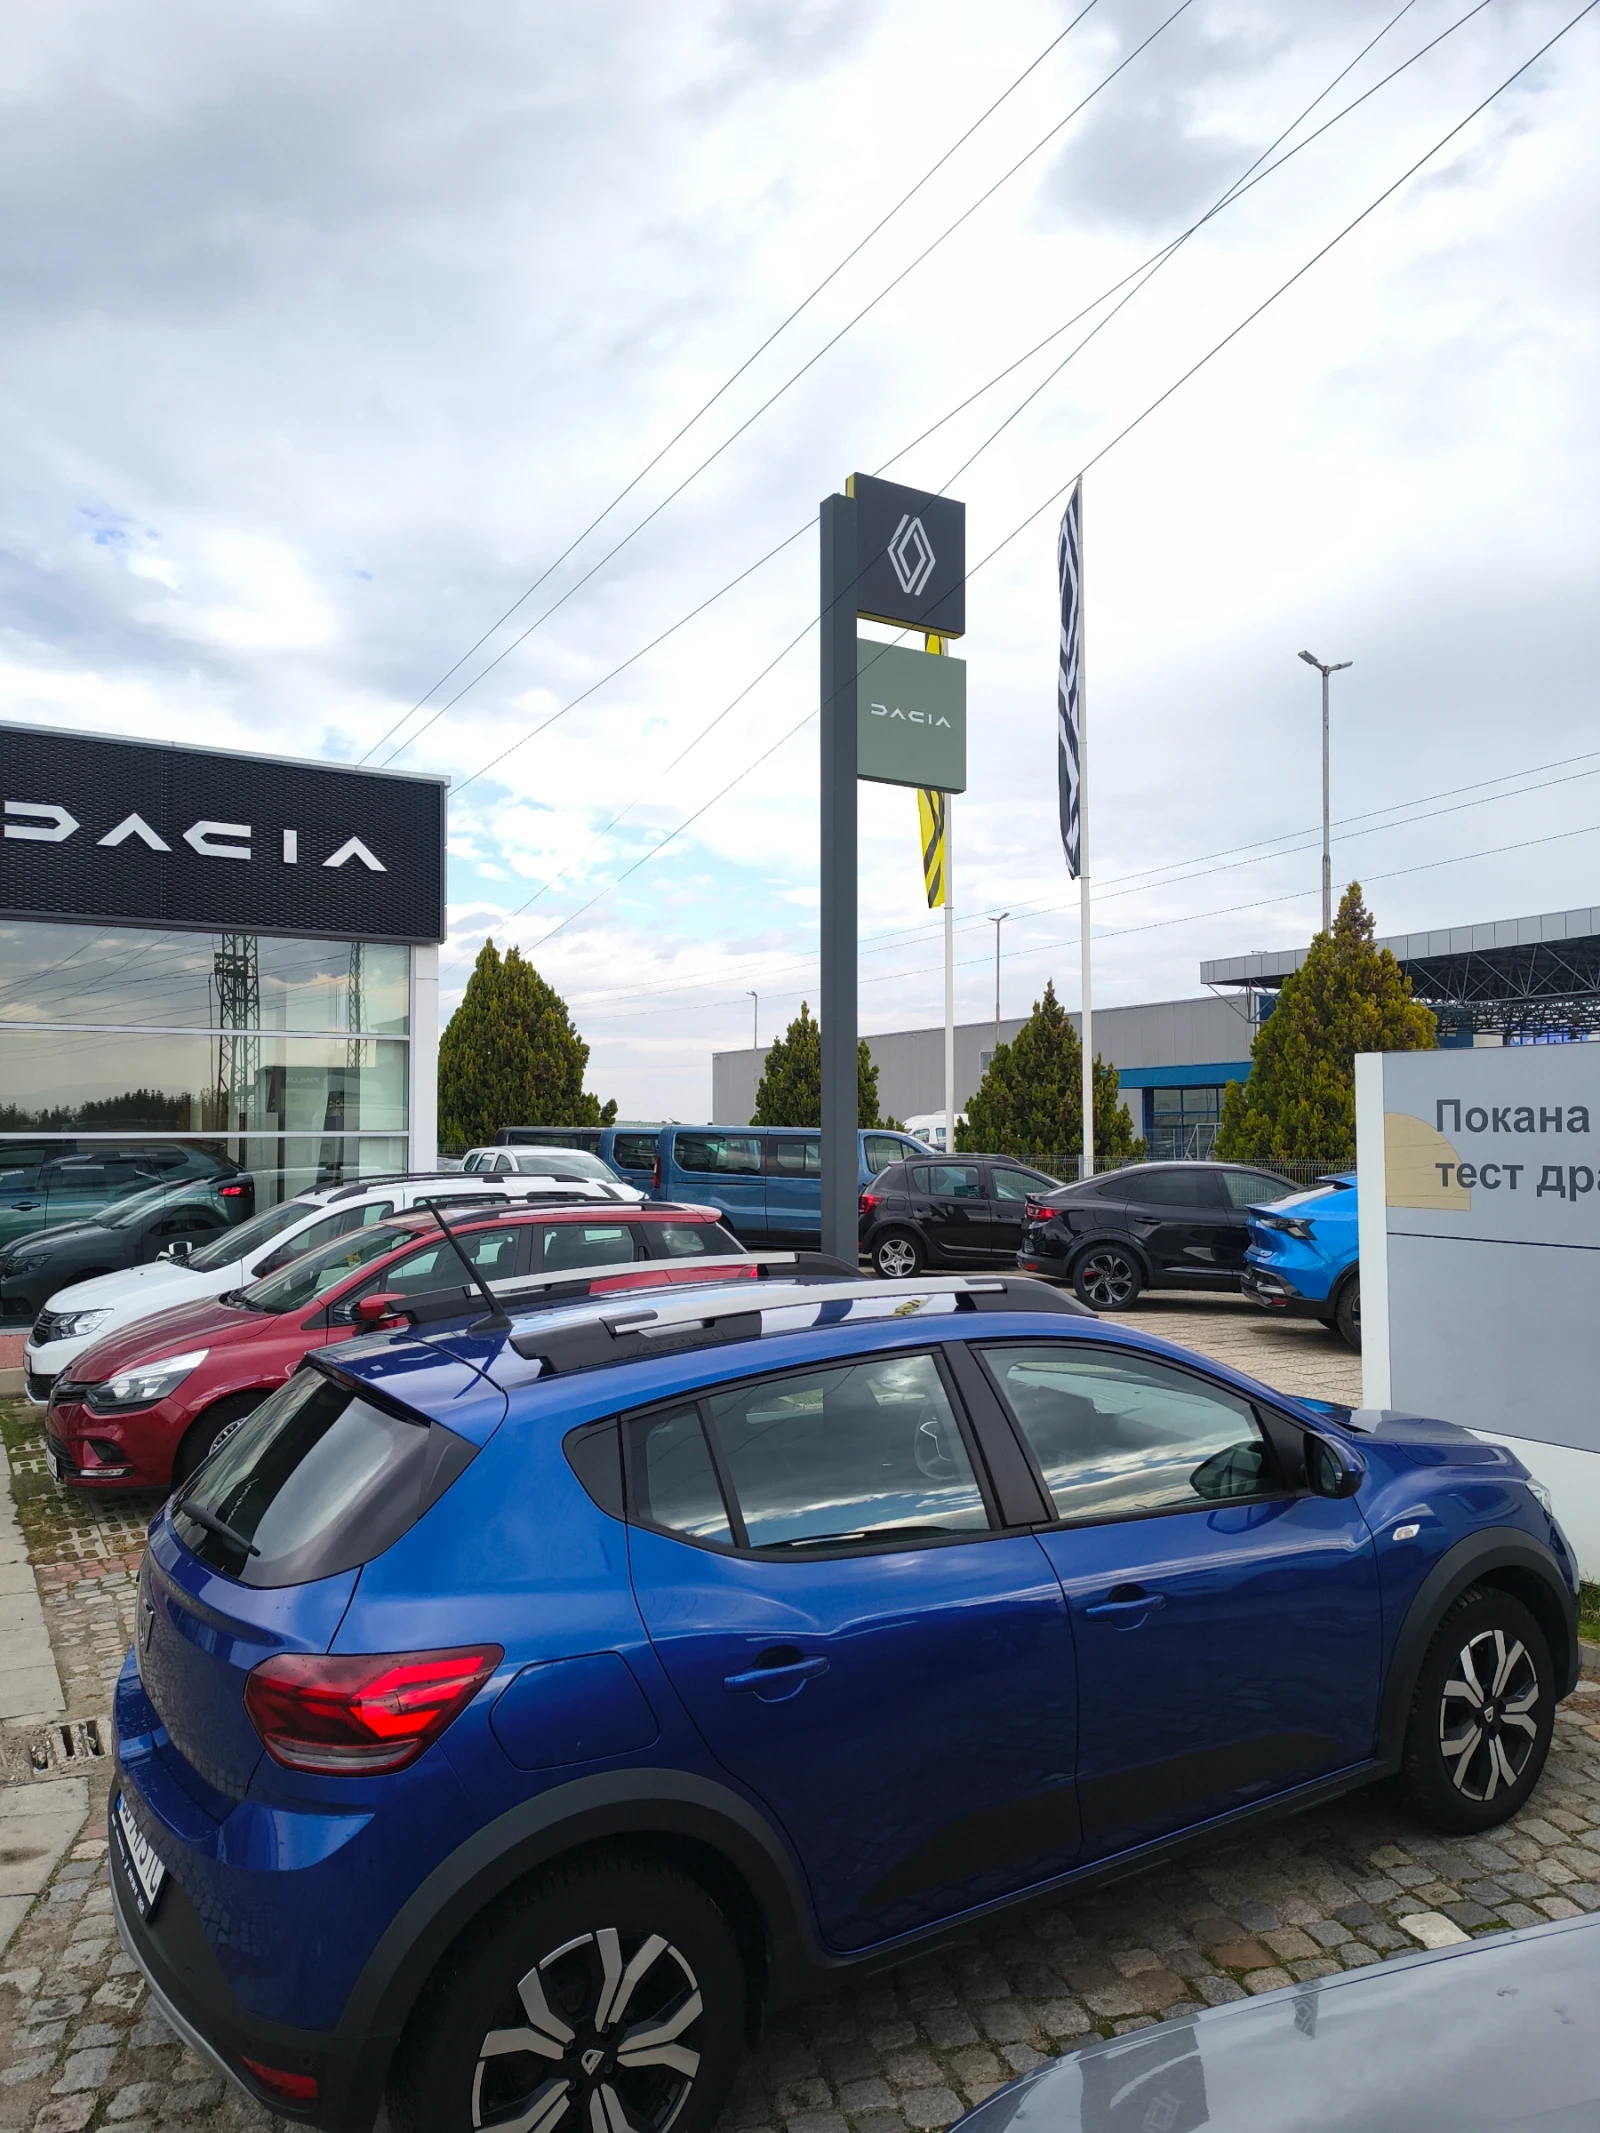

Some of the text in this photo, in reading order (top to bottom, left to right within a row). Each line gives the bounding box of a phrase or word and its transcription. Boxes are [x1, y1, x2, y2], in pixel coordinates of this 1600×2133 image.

[871, 703, 951, 728] DACIA
[4, 801, 387, 871] DACIA
[1437, 1099, 1590, 1133] Покана
[1435, 1162, 1600, 1202] тест др
